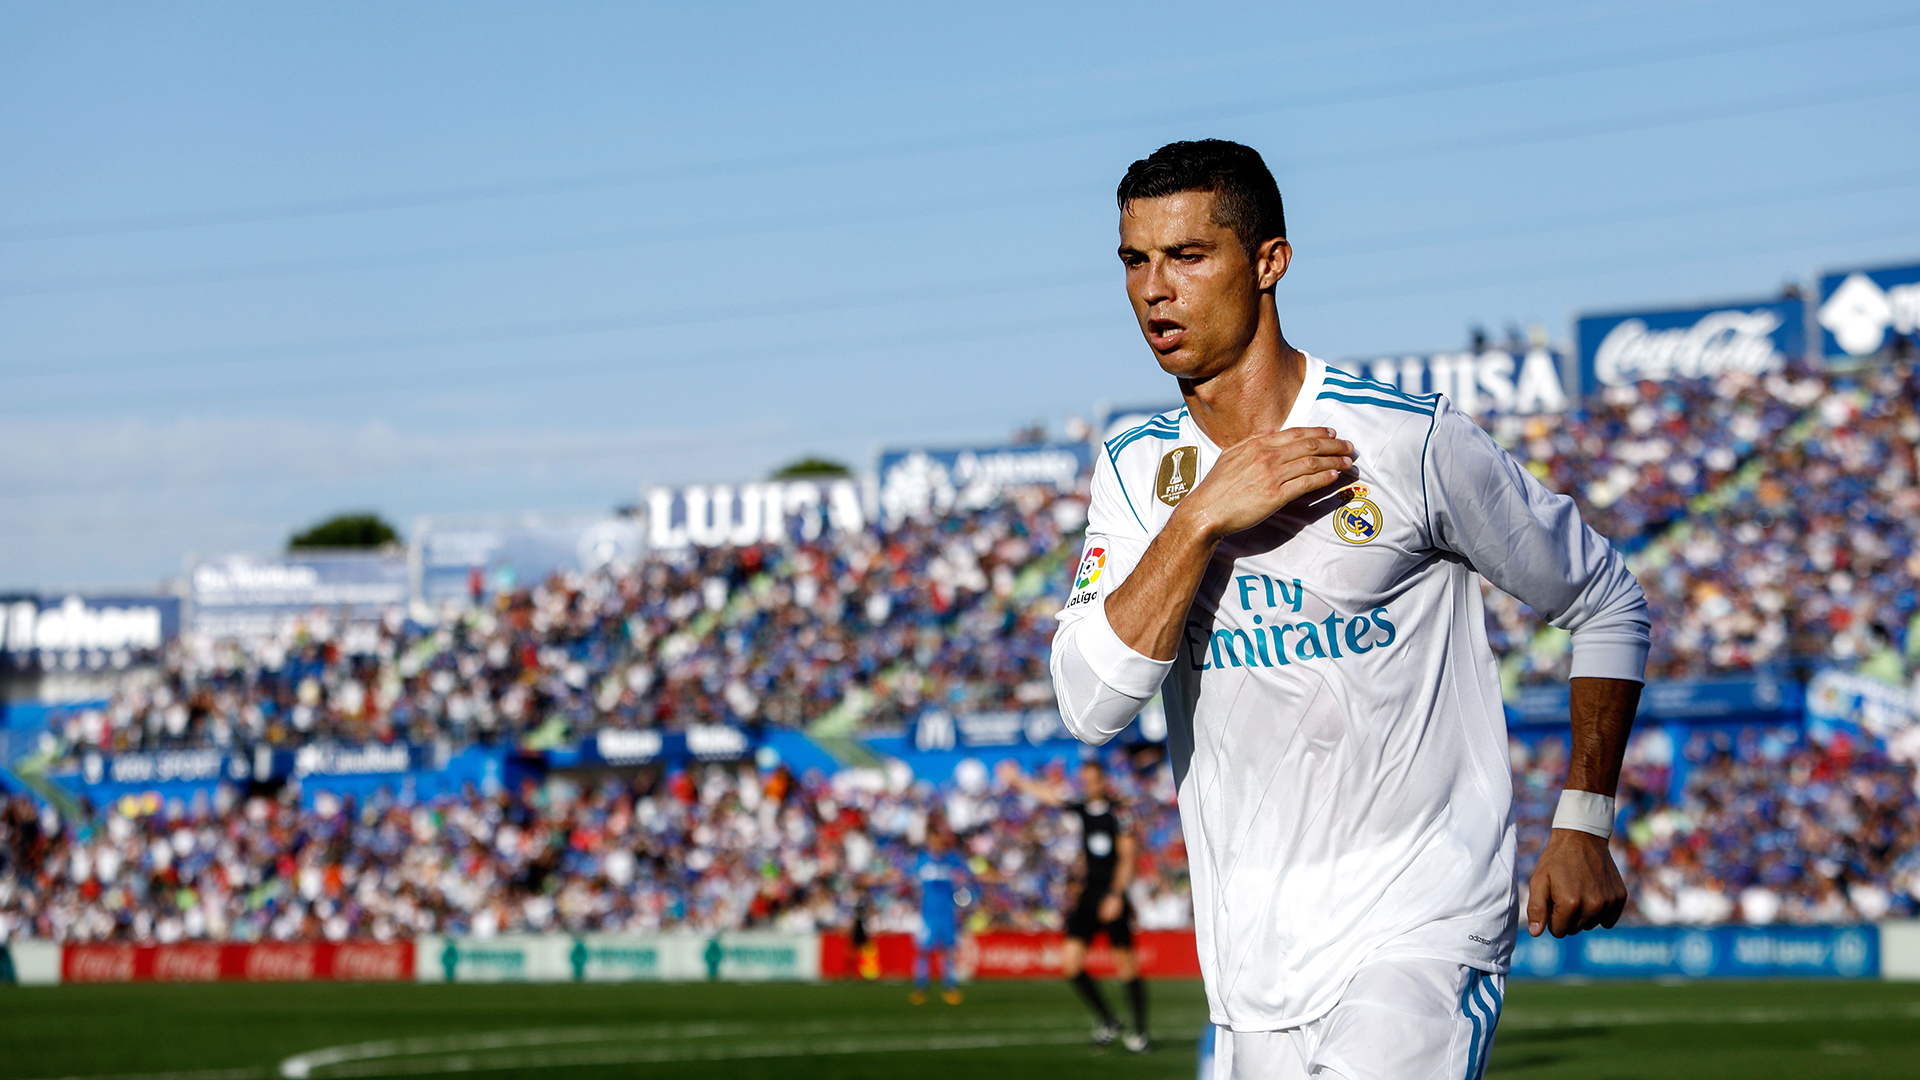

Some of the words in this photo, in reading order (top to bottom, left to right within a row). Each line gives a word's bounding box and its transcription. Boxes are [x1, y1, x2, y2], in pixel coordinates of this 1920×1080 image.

[1166, 482, 1185, 495] FIFA
[1235, 574, 1303, 613] Fly
[1183, 606, 1396, 671] Emirates
